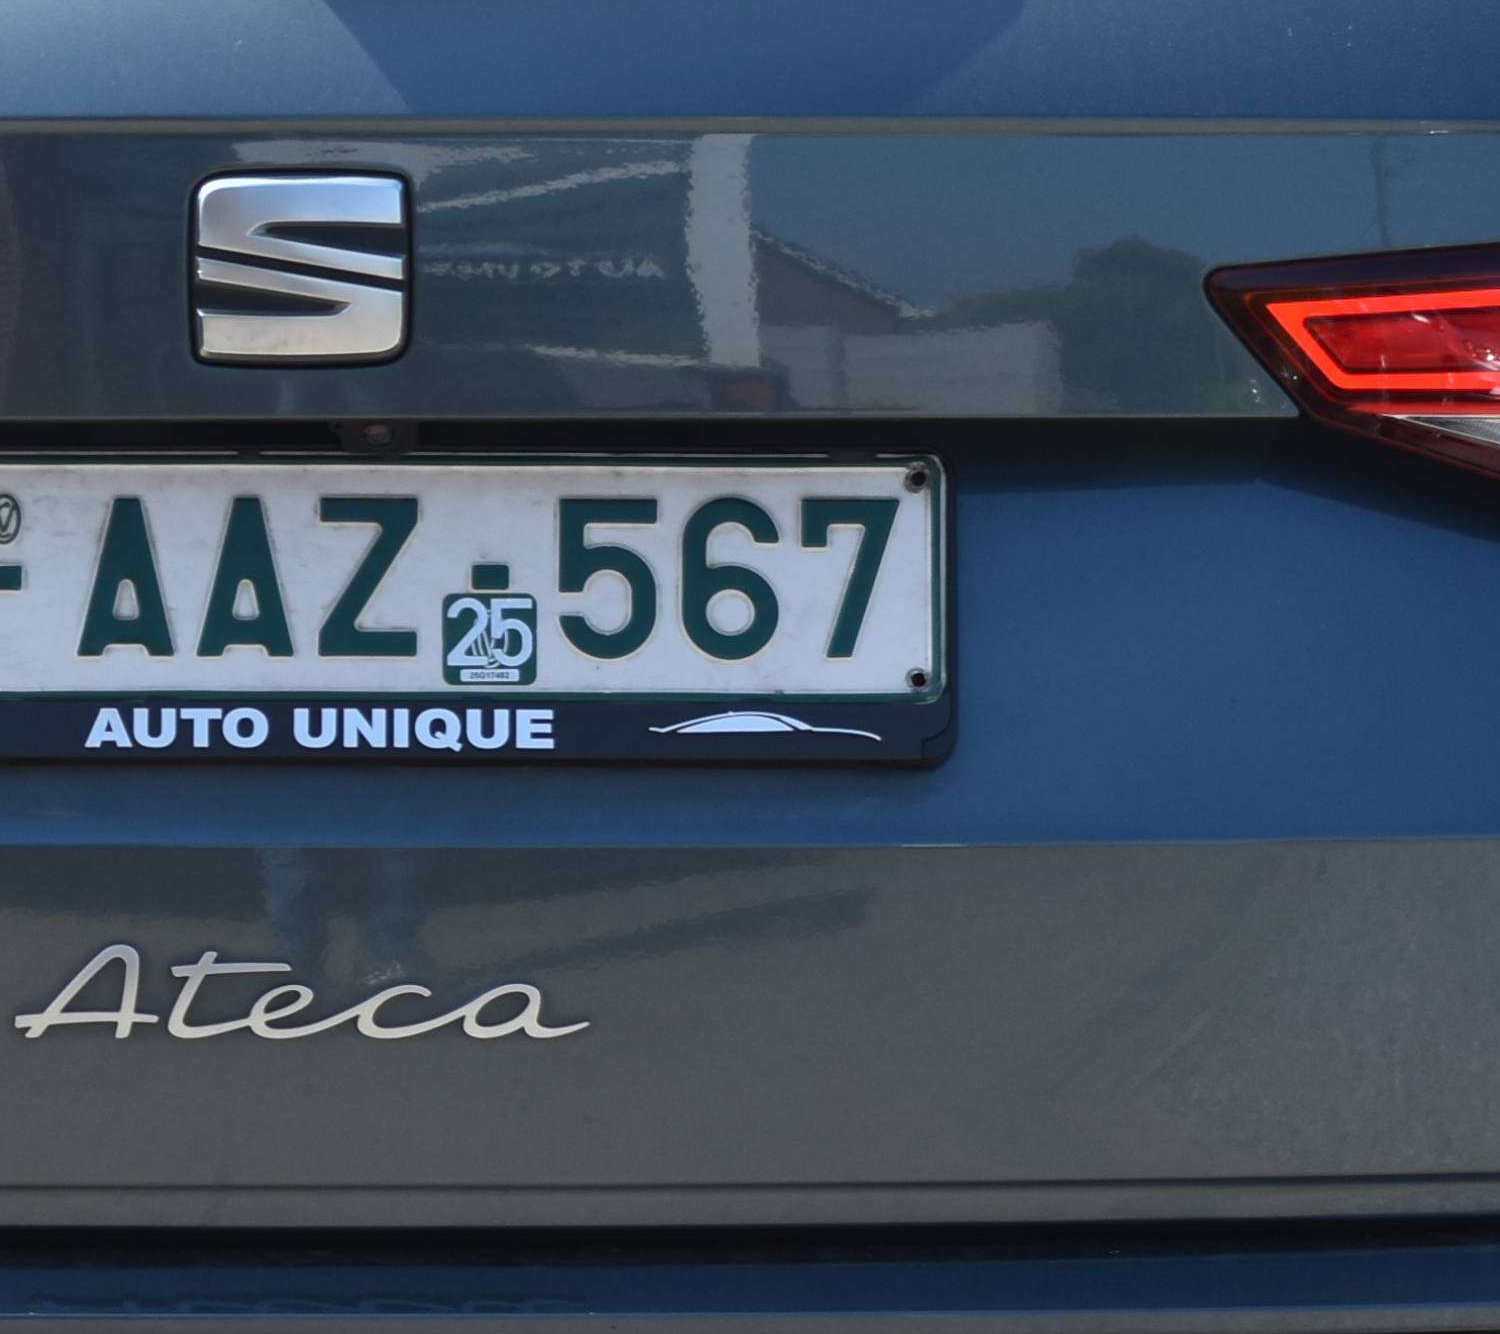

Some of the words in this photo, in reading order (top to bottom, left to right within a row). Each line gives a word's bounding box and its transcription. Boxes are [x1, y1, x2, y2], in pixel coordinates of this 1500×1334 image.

[446, 597, 533, 667] 25
[85, 708, 270, 747] AUTO
[291, 708, 556, 753] UNIQUE
[14, 944, 590, 1039] Ateca
